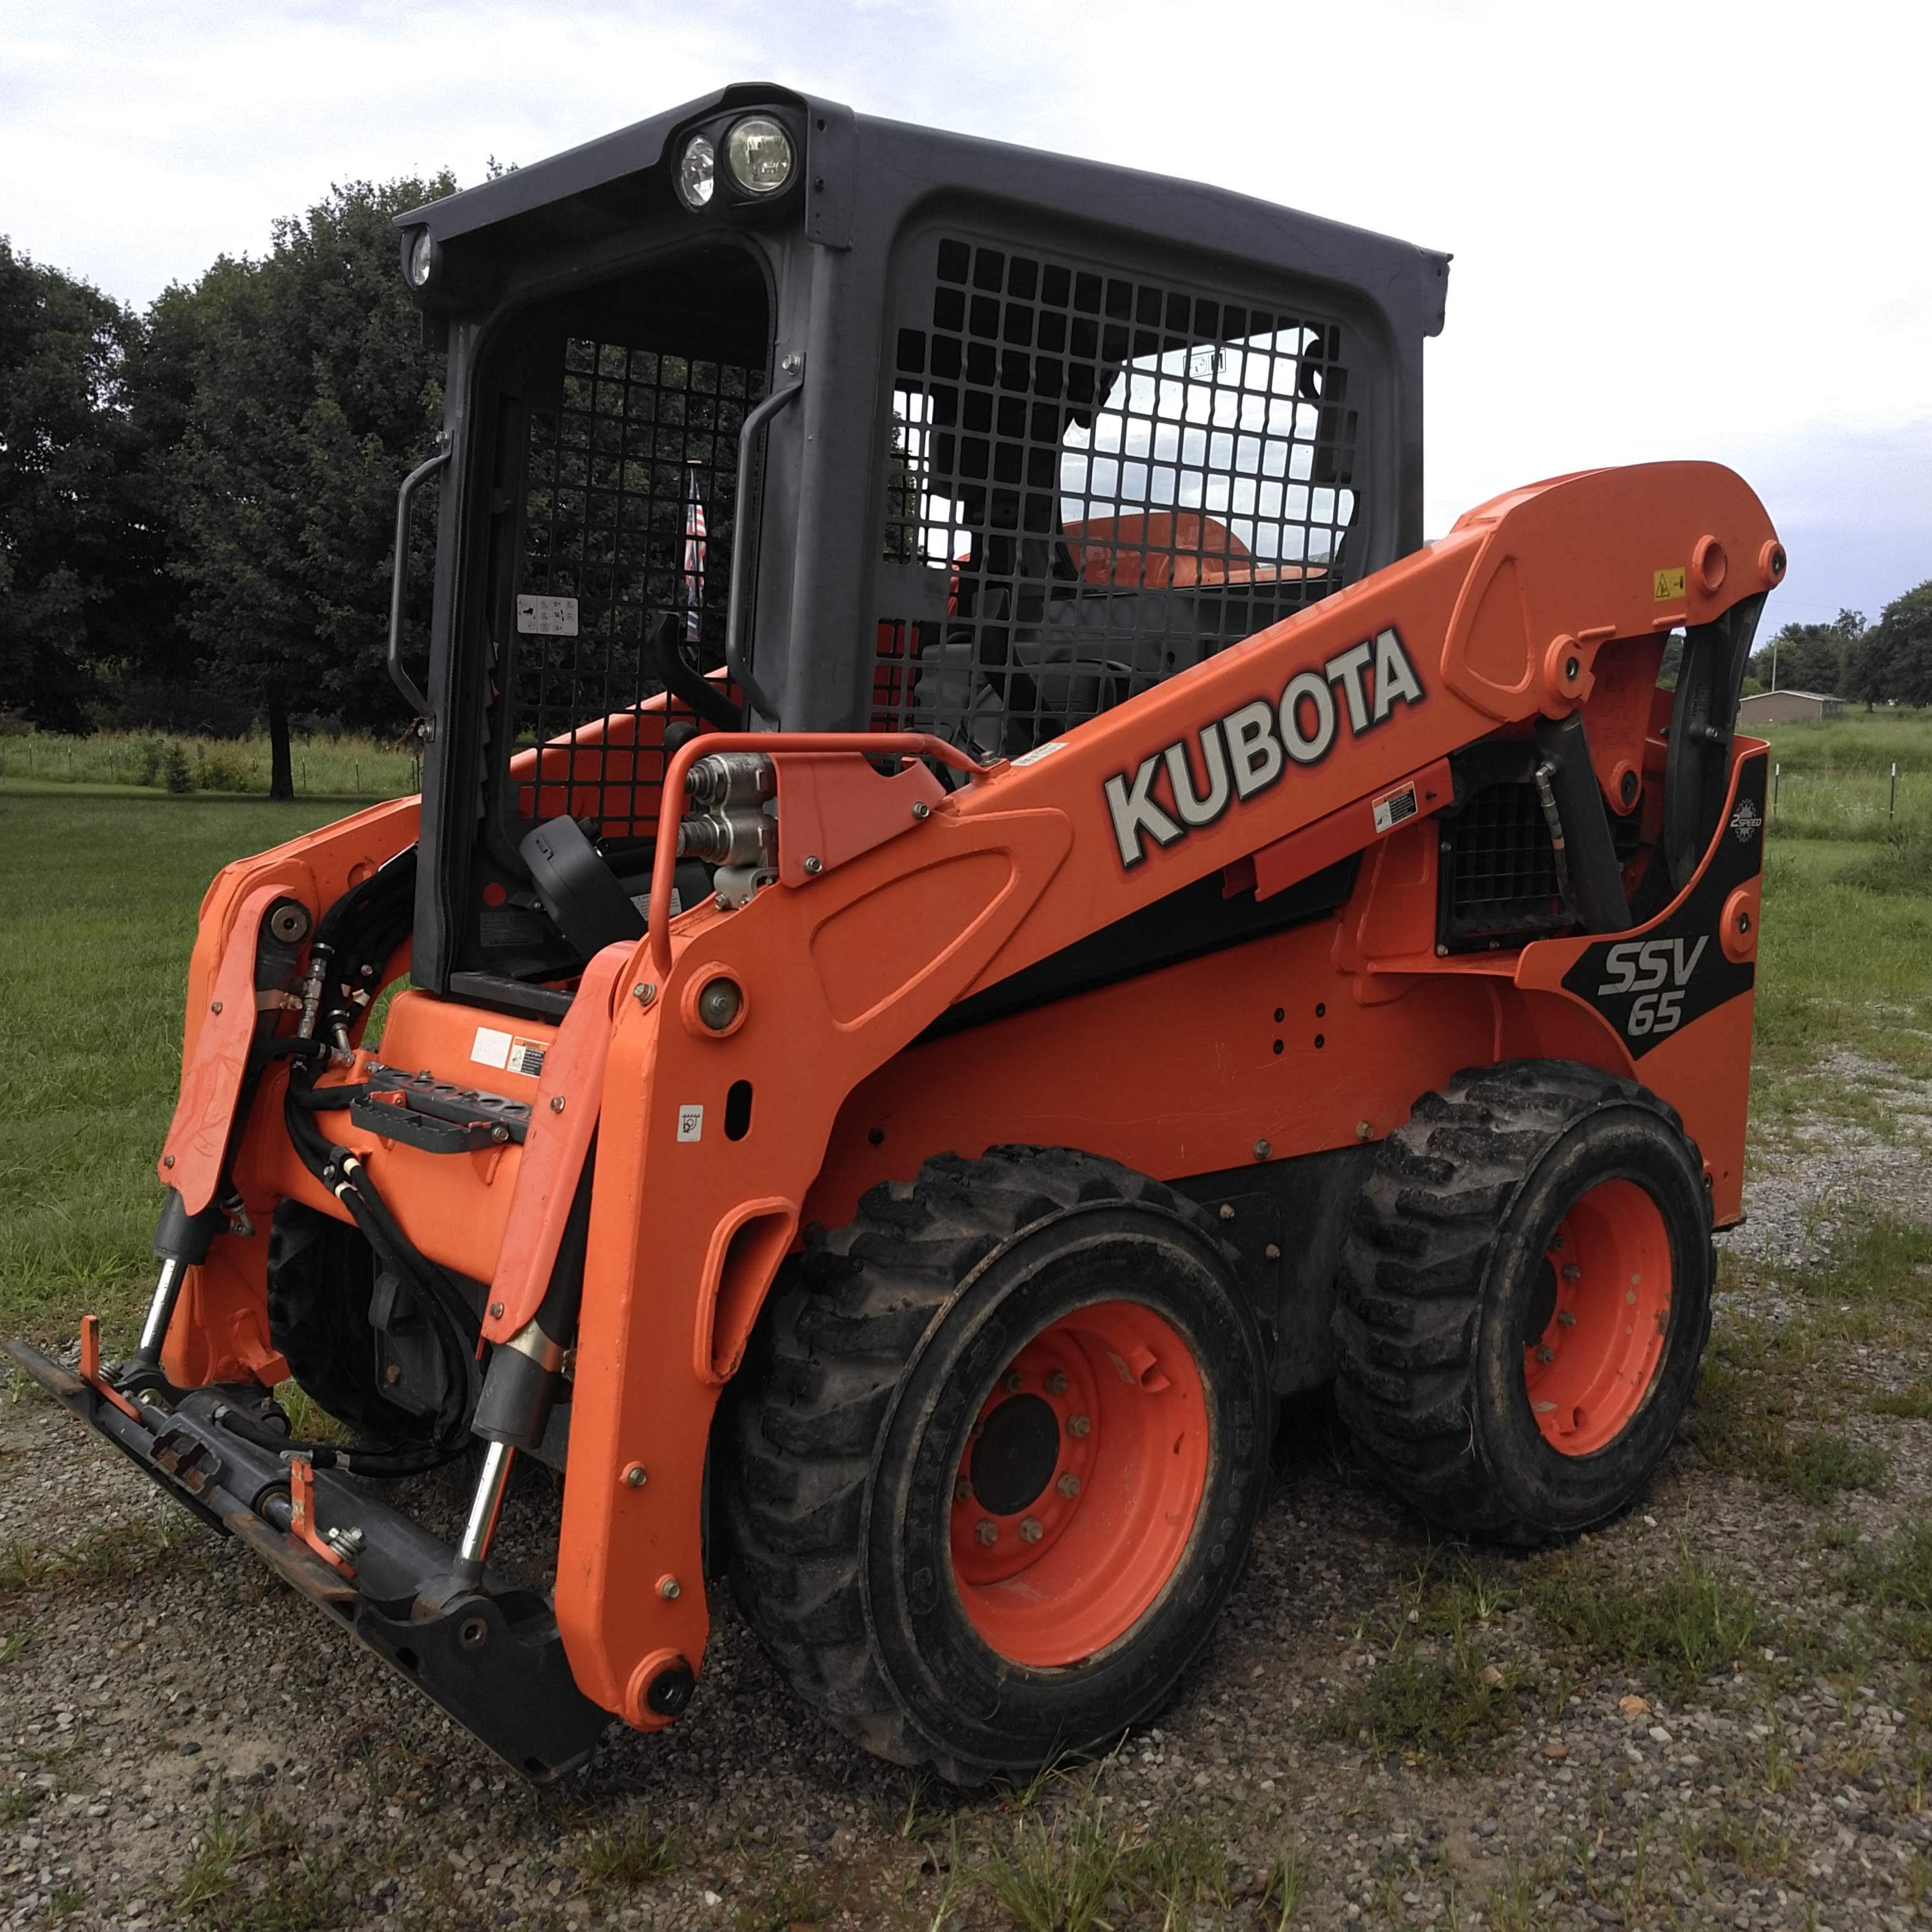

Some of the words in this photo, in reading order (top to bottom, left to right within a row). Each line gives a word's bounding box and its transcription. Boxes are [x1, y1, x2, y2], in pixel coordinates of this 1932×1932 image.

[1104, 628, 1423, 867] KUBOTA
[1598, 935, 1709, 995] SSV
[1627, 990, 1685, 1036] 65
